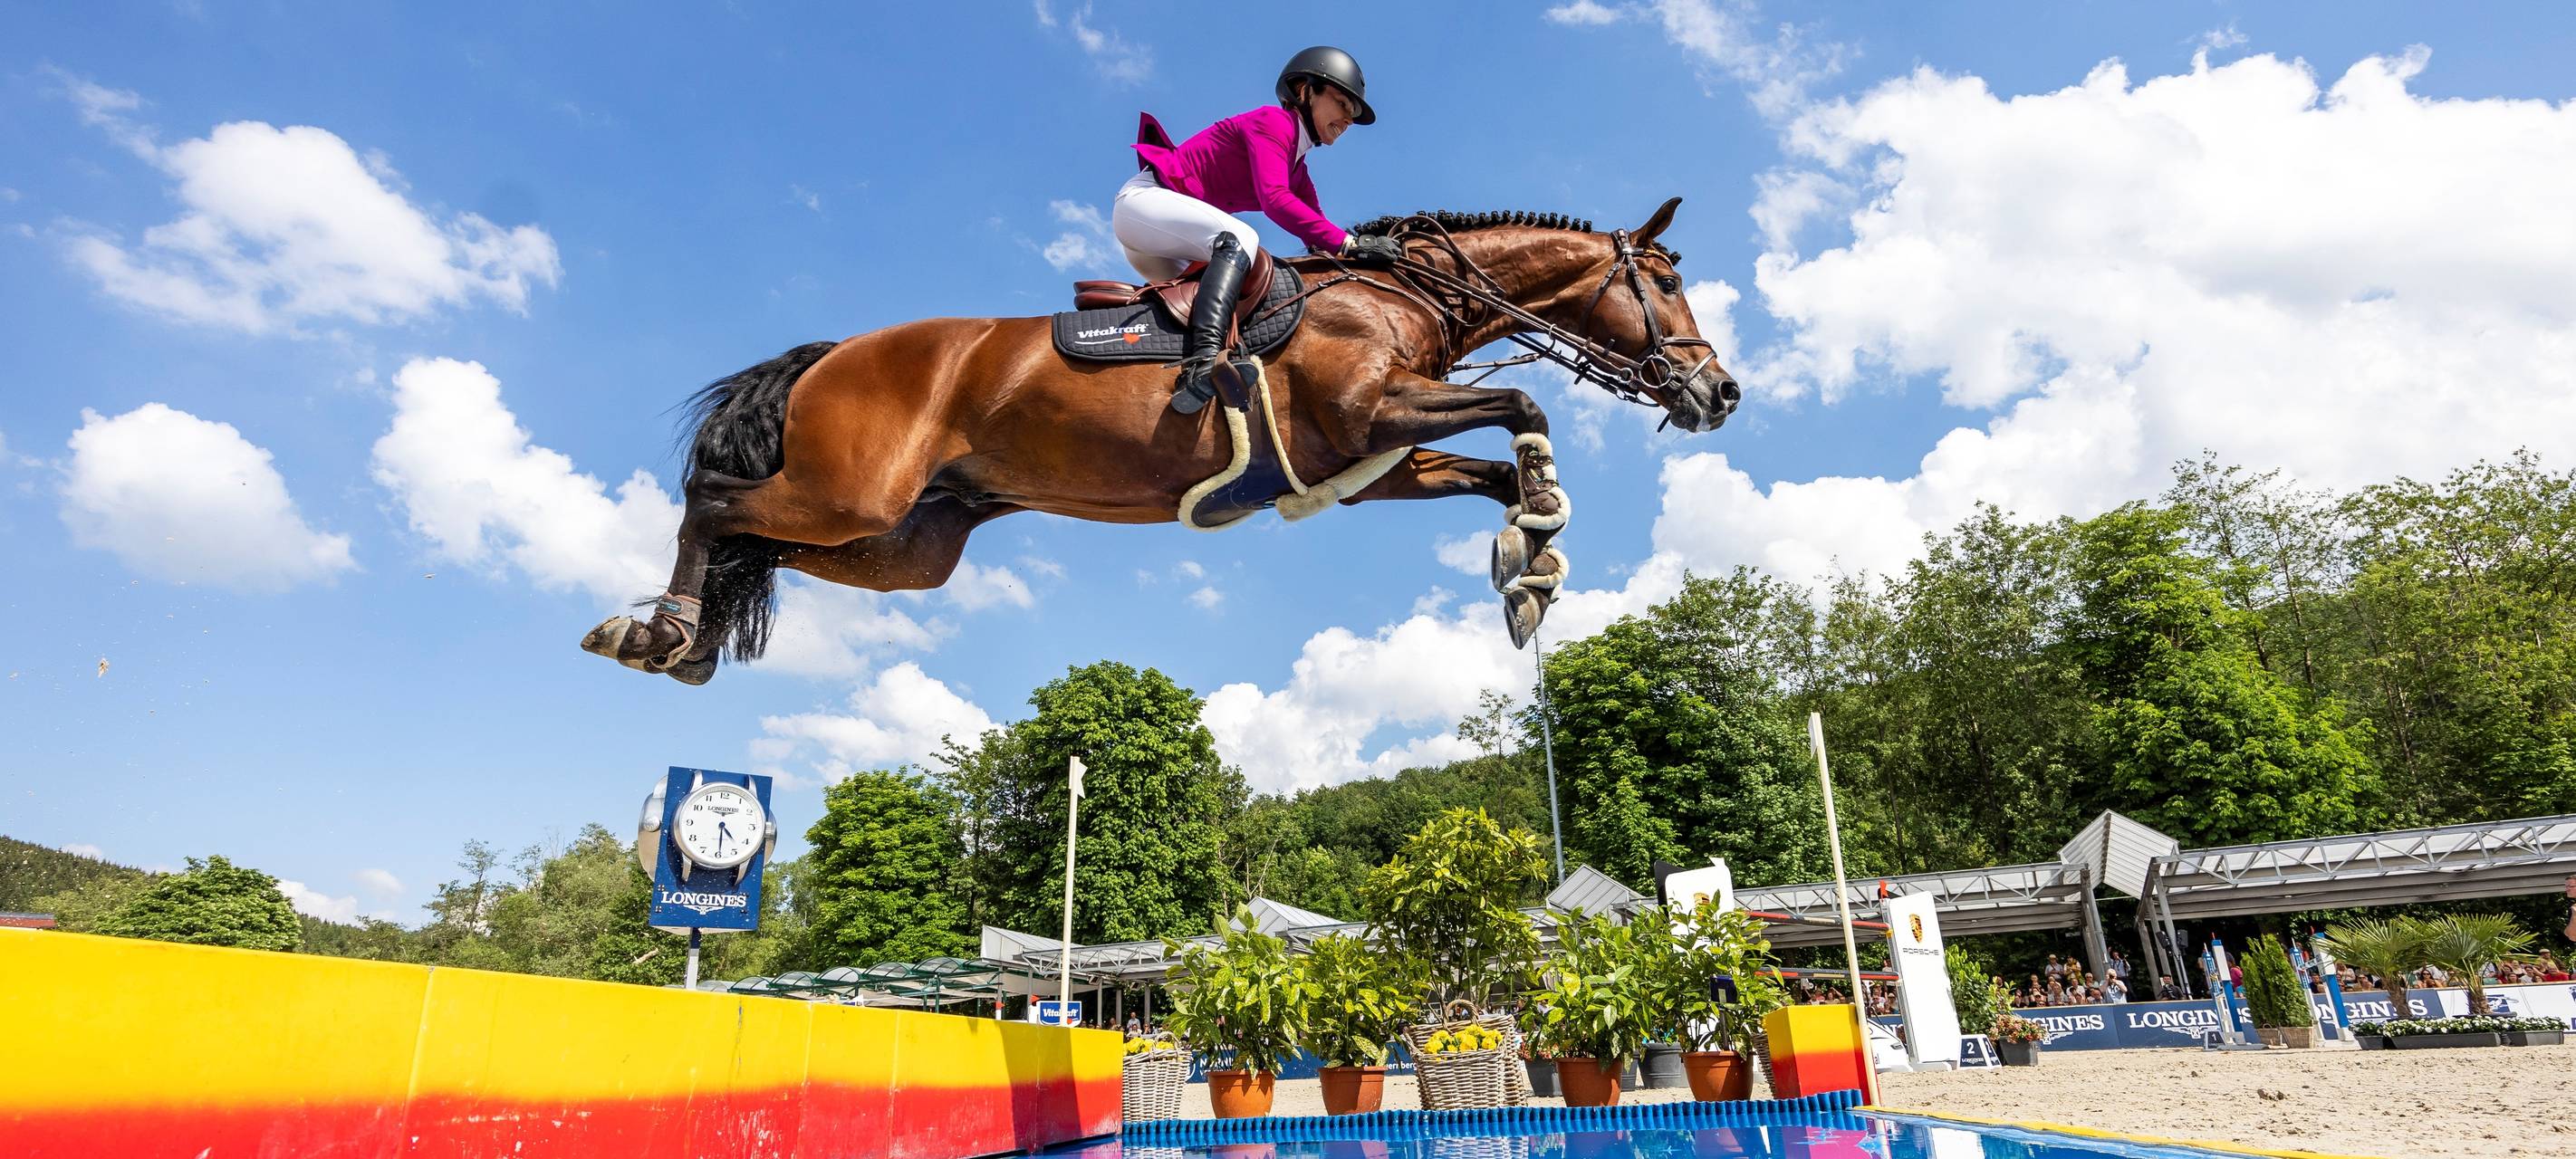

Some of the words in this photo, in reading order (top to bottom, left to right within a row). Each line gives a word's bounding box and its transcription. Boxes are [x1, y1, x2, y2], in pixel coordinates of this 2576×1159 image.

[1077, 323, 1149, 338] Vitakraft
[688, 834, 697, 842] 8
[699, 846, 707, 854] 7
[715, 851, 722, 859] 6
[661, 892, 746, 907] LONGINES
[1902, 947, 1939, 956] PORSCHE
[2127, 1007, 2253, 1029] LONGINS
[1966, 1041, 1975, 1054] 2
